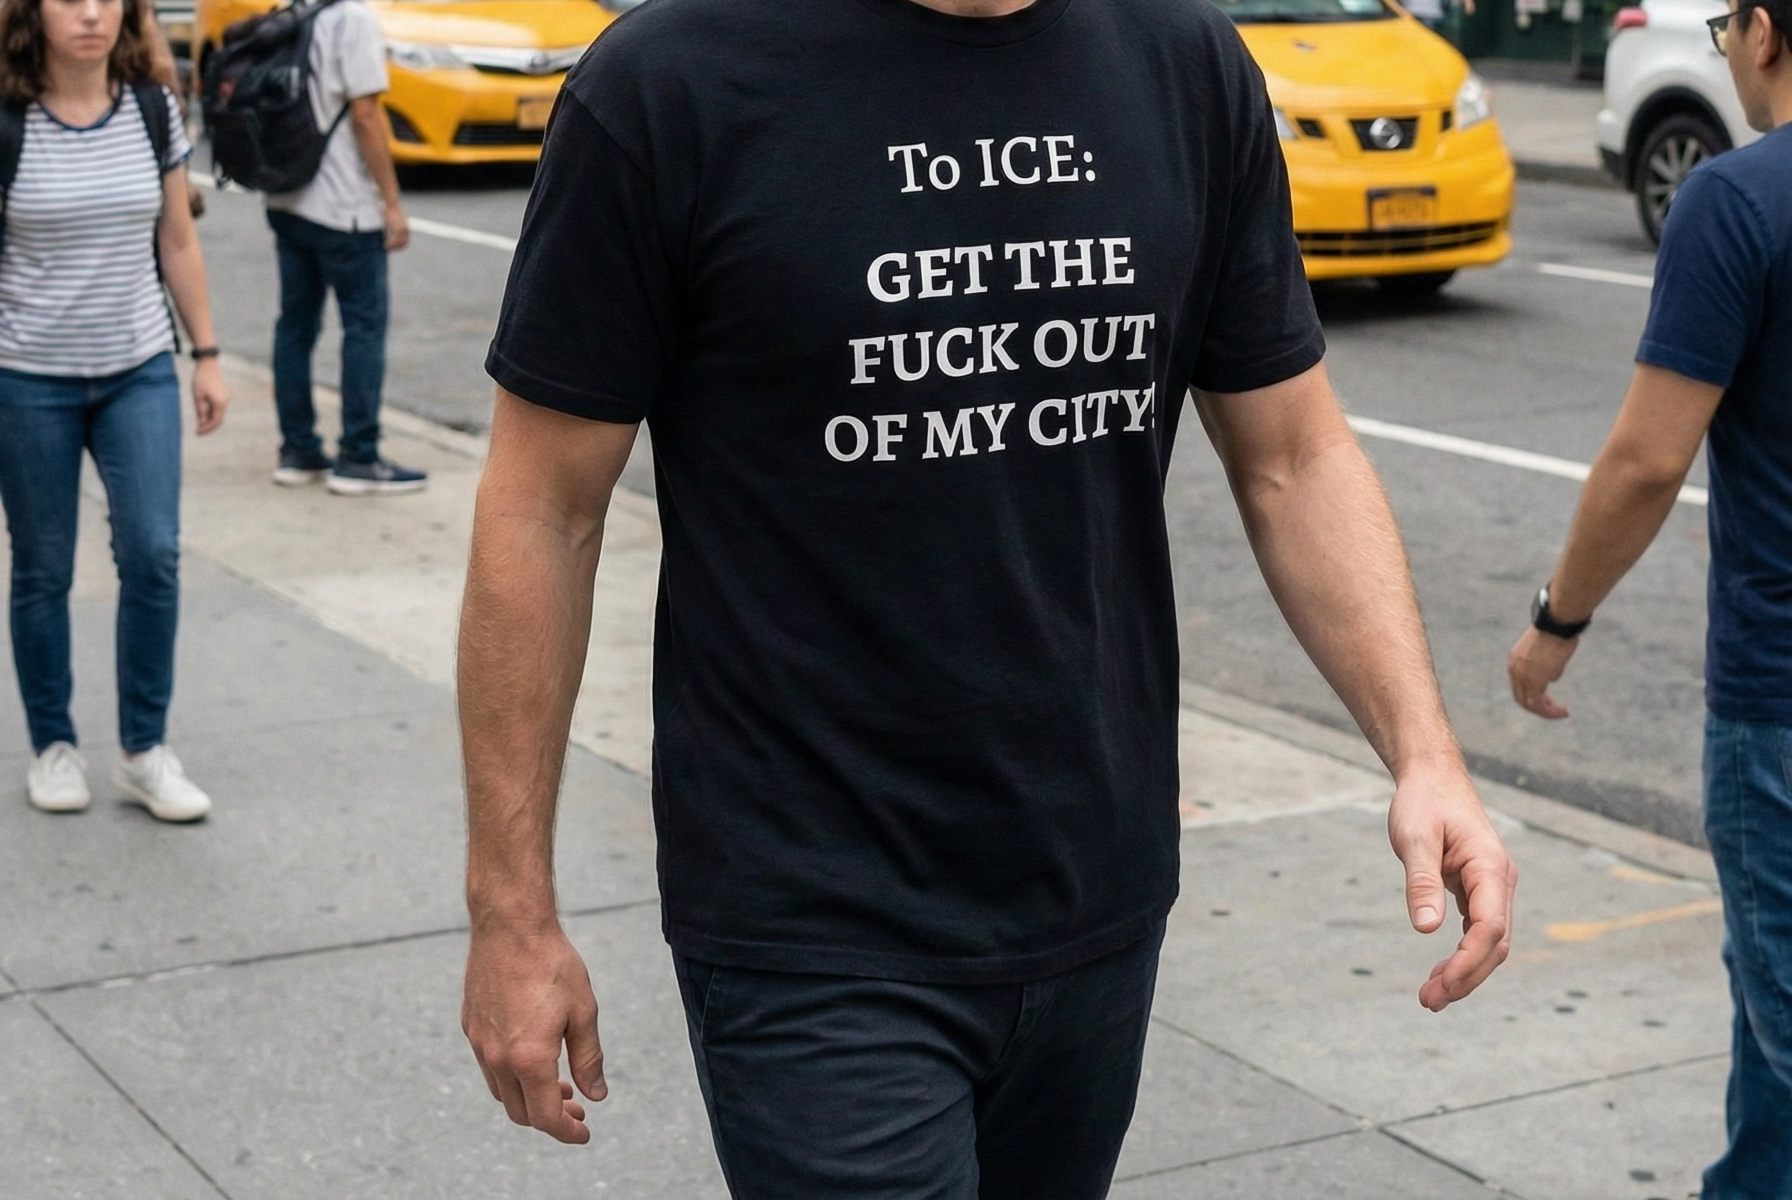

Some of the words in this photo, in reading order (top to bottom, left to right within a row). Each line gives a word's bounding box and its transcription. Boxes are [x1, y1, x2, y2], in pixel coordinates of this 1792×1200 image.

[887, 142, 961, 194] To
[974, 134, 1096, 188] ICE:
[866, 243, 994, 303] GET
[1004, 236, 1135, 291] THE
[848, 322, 1020, 385] FUCK
[1033, 313, 1156, 368] OUT
[824, 413, 908, 462] OF
[922, 402, 1016, 460] MY
[1028, 381, 1156, 446] CITY
